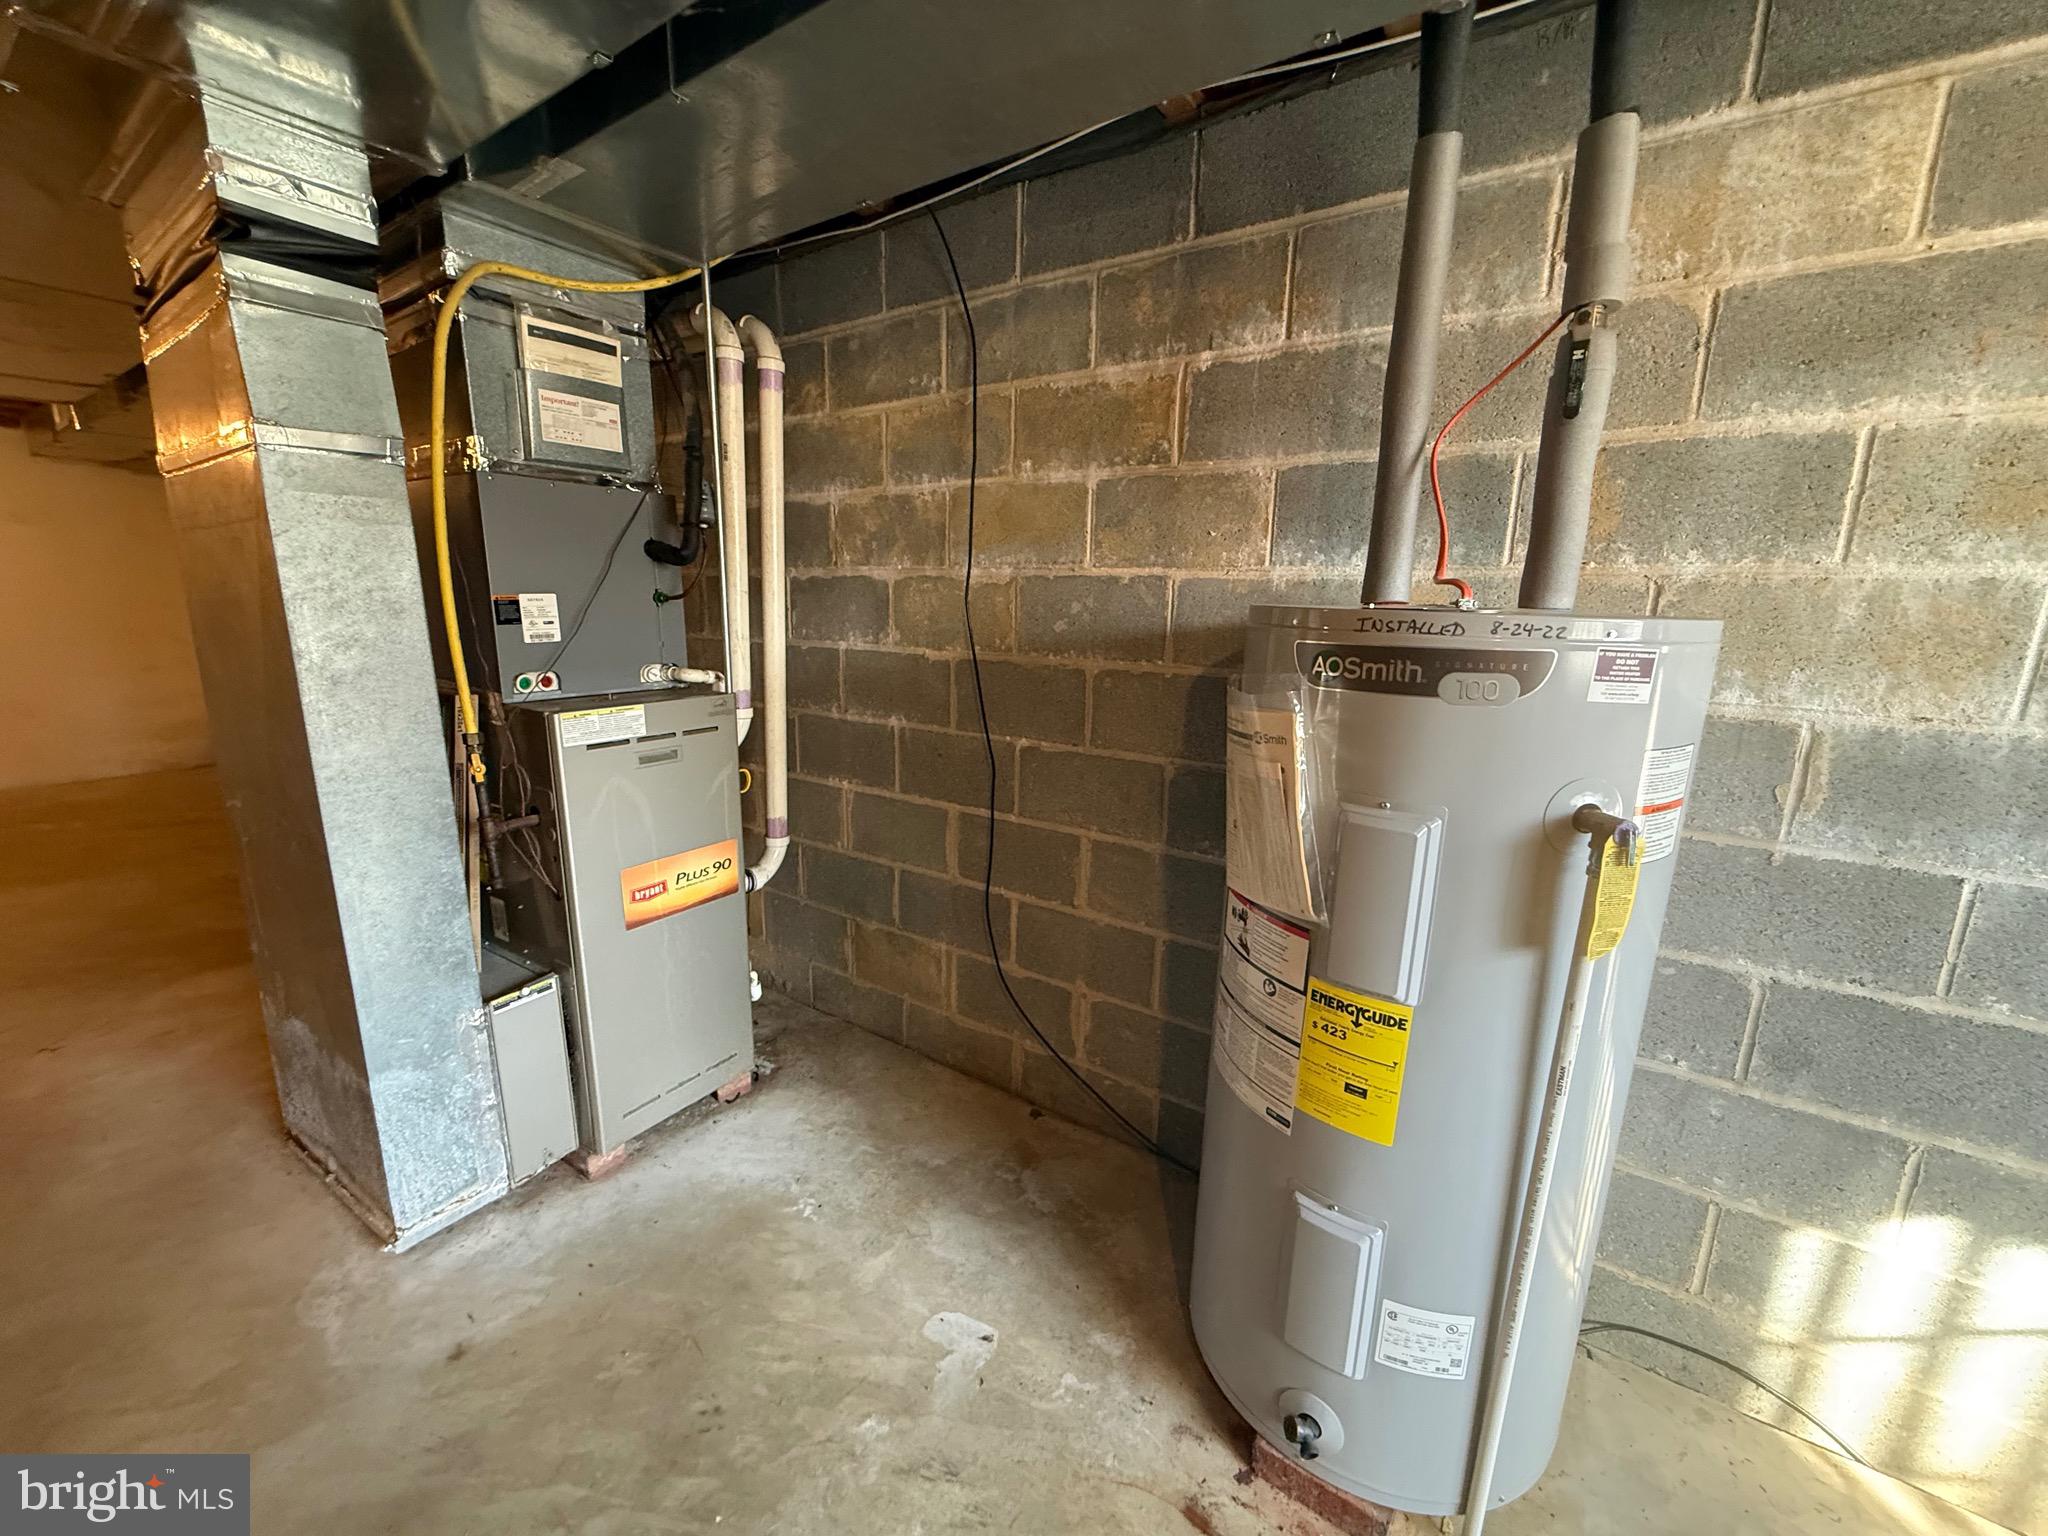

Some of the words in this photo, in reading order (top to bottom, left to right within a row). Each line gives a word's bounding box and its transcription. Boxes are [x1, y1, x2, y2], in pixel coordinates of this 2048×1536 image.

[1353, 617, 1465, 636] INSTALLED
[1490, 620, 1567, 640] 8-24-22
[1435, 661, 1529, 672] SIGNATURE
[1456, 679, 1500, 701] 100
[712, 858, 732, 873] 90
[634, 882, 665, 900] bryant
[1311, 988, 1408, 1031] ENERGYGUIDE
[1312, 1020, 1318, 1029] $
[1321, 1023, 1347, 1040] 423
[1556, 1065, 1566, 1097] EASTMAN
